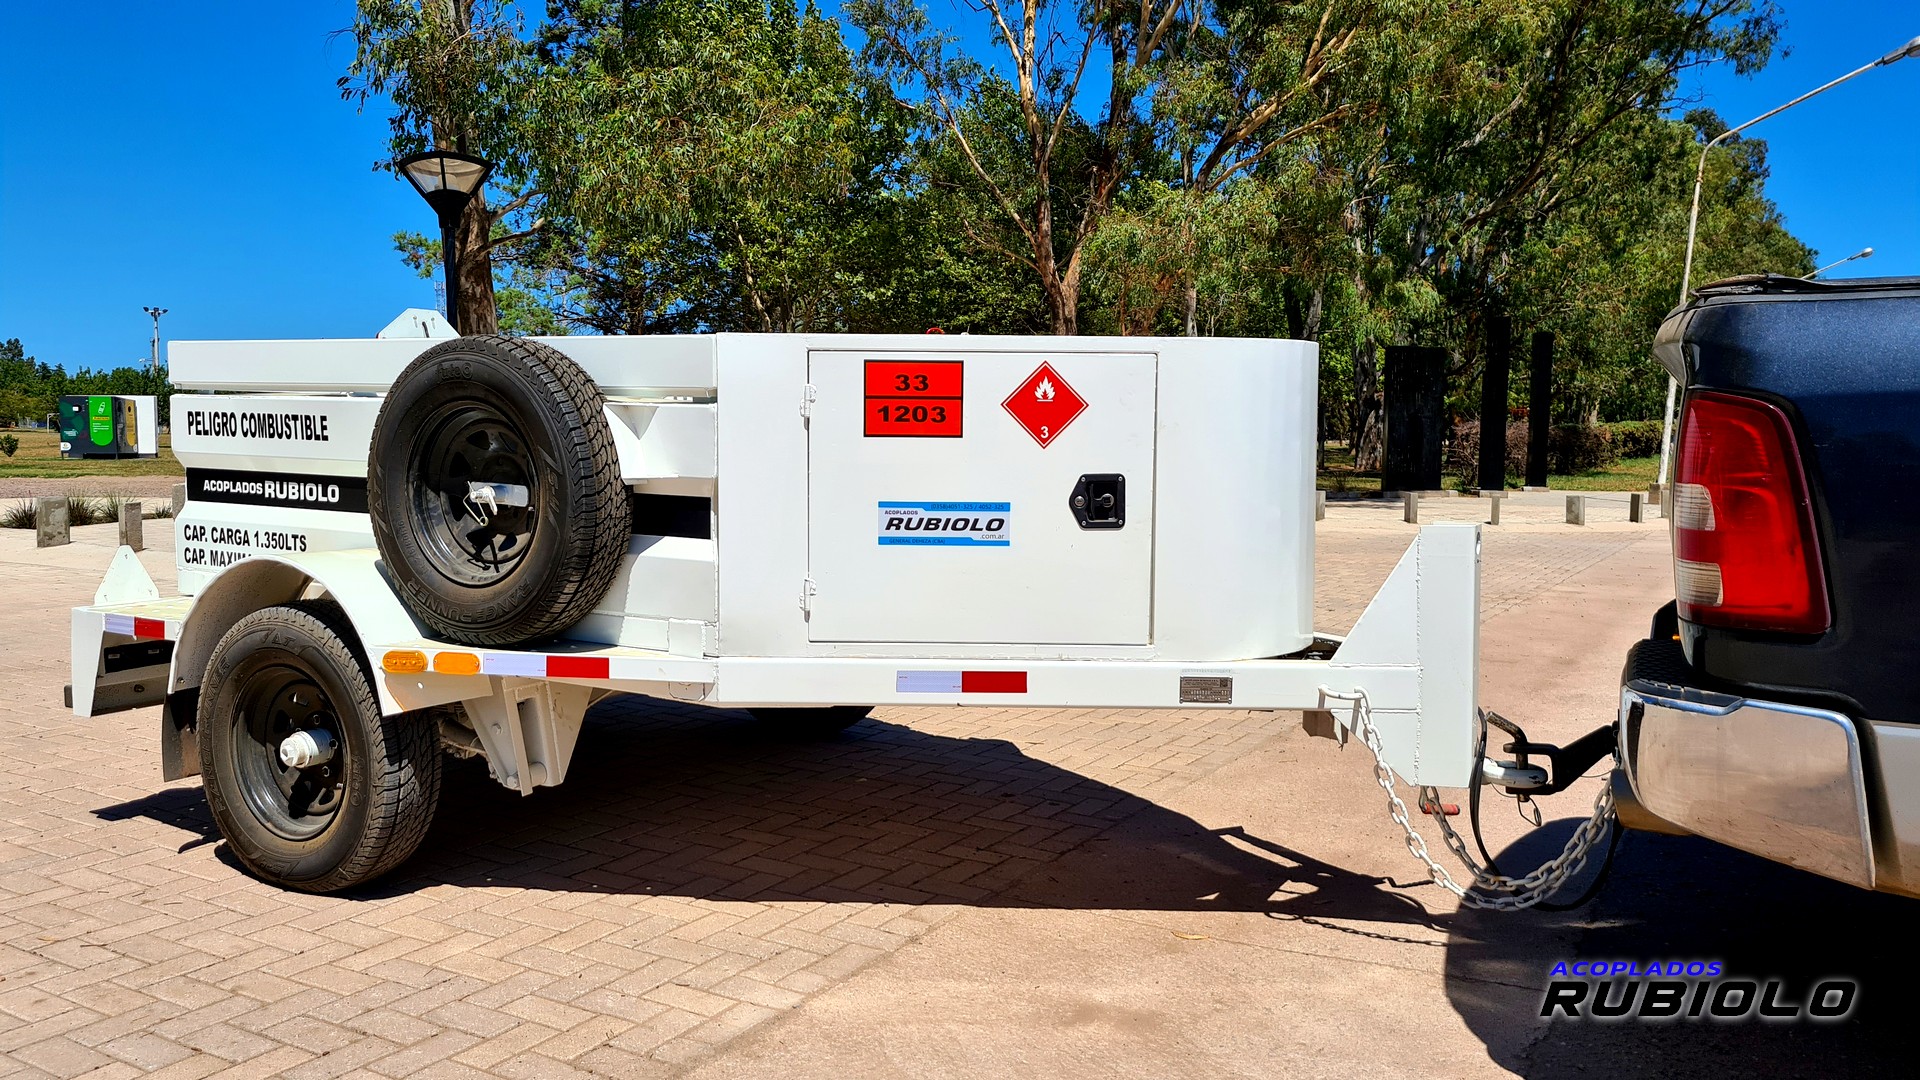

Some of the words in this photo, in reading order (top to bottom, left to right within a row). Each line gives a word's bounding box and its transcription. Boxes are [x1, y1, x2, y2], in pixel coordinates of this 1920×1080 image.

[894, 374, 929, 392] 33
[877, 405, 947, 423] 1203
[187, 411, 237, 438] PELIGRO
[240, 412, 329, 442] COMBUSTIBLE
[1040, 425, 1050, 439] 3
[203, 479, 263, 495] ACOPLADOS
[264, 480, 340, 503] RUBIOLO
[884, 517, 1005, 531] RUBIOLO
[184, 524, 208, 543] CAP.
[211, 526, 251, 547] CARGA
[254, 530, 307, 552] 1.350LTS
[184, 547, 207, 565] CAP.
